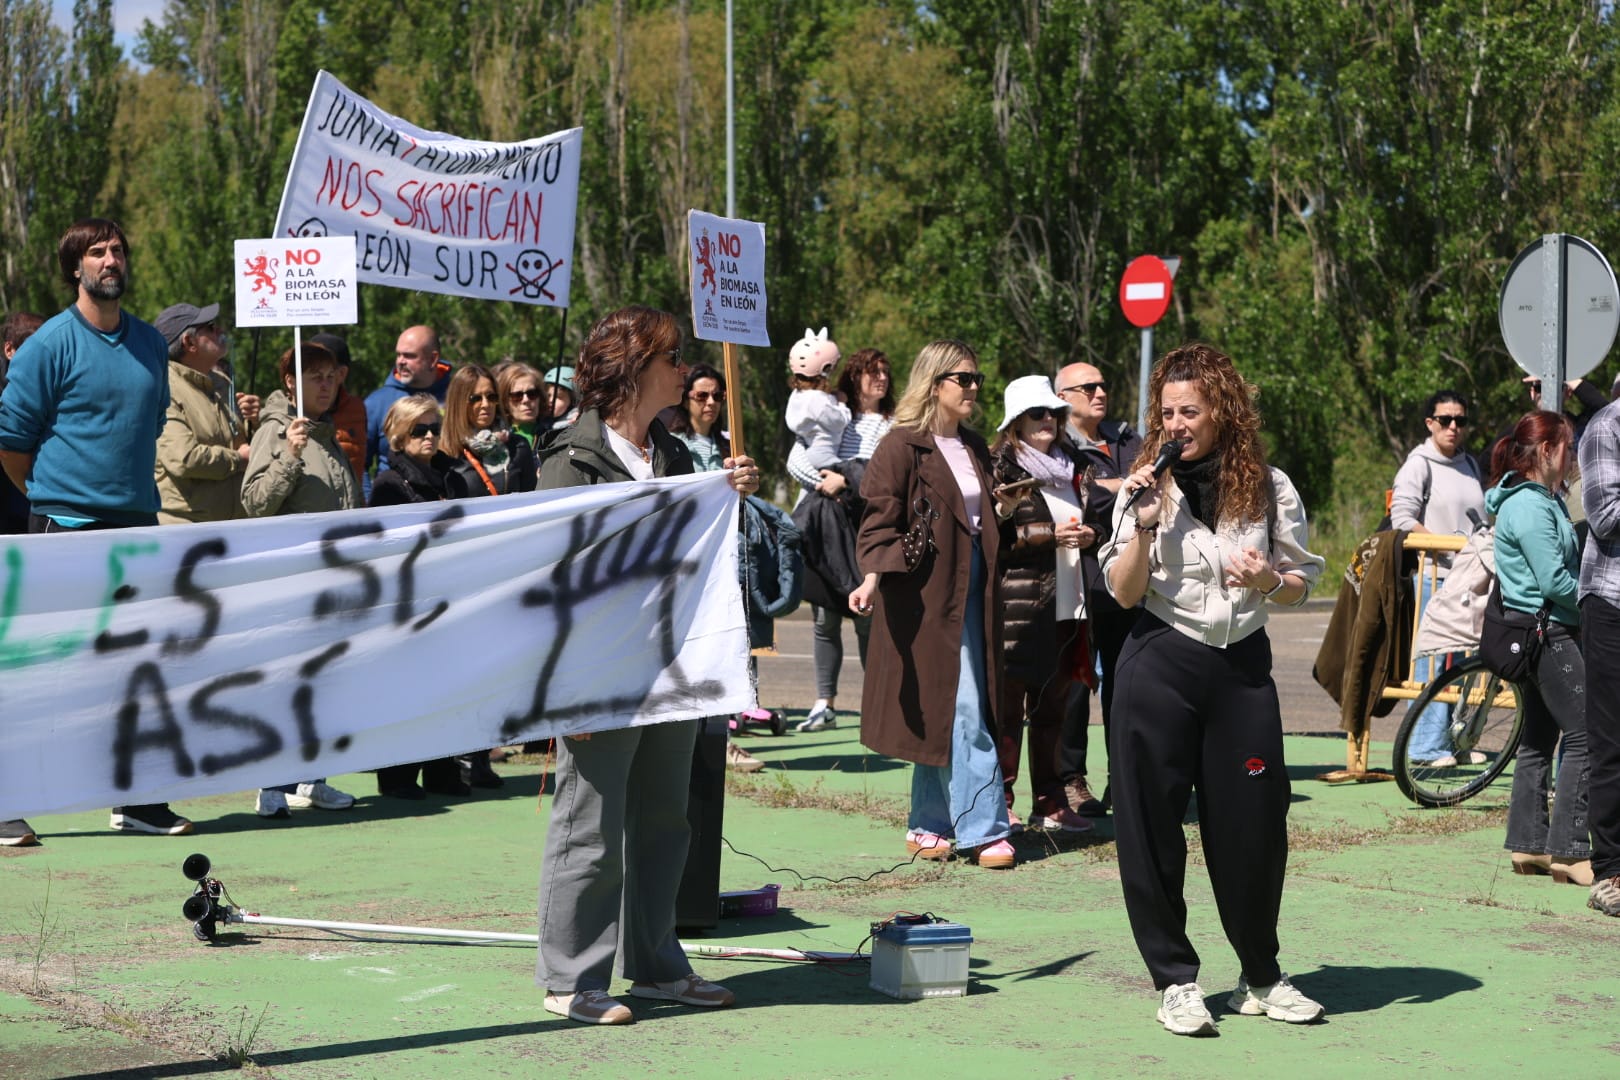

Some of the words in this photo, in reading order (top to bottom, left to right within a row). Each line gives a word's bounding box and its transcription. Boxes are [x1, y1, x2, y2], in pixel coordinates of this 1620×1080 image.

[318, 89, 400, 158] JUNTA
[316, 155, 384, 217] NOS
[393, 180, 543, 245] SACRIFICAN
[718, 231, 741, 258] NO
[285, 249, 321, 266] NO
[286, 268, 295, 277] A
[298, 268, 315, 277] LA
[434, 245, 498, 290] SUR
[720, 260, 726, 273] A
[727, 261, 739, 275] LA
[285, 279, 347, 290] BIOMASA
[720, 278, 760, 295] BIOMASA
[285, 292, 302, 301] EN
[306, 290, 341, 301] LEÓN
[720, 295, 732, 308] EN
[735, 295, 757, 311] LEÓN
